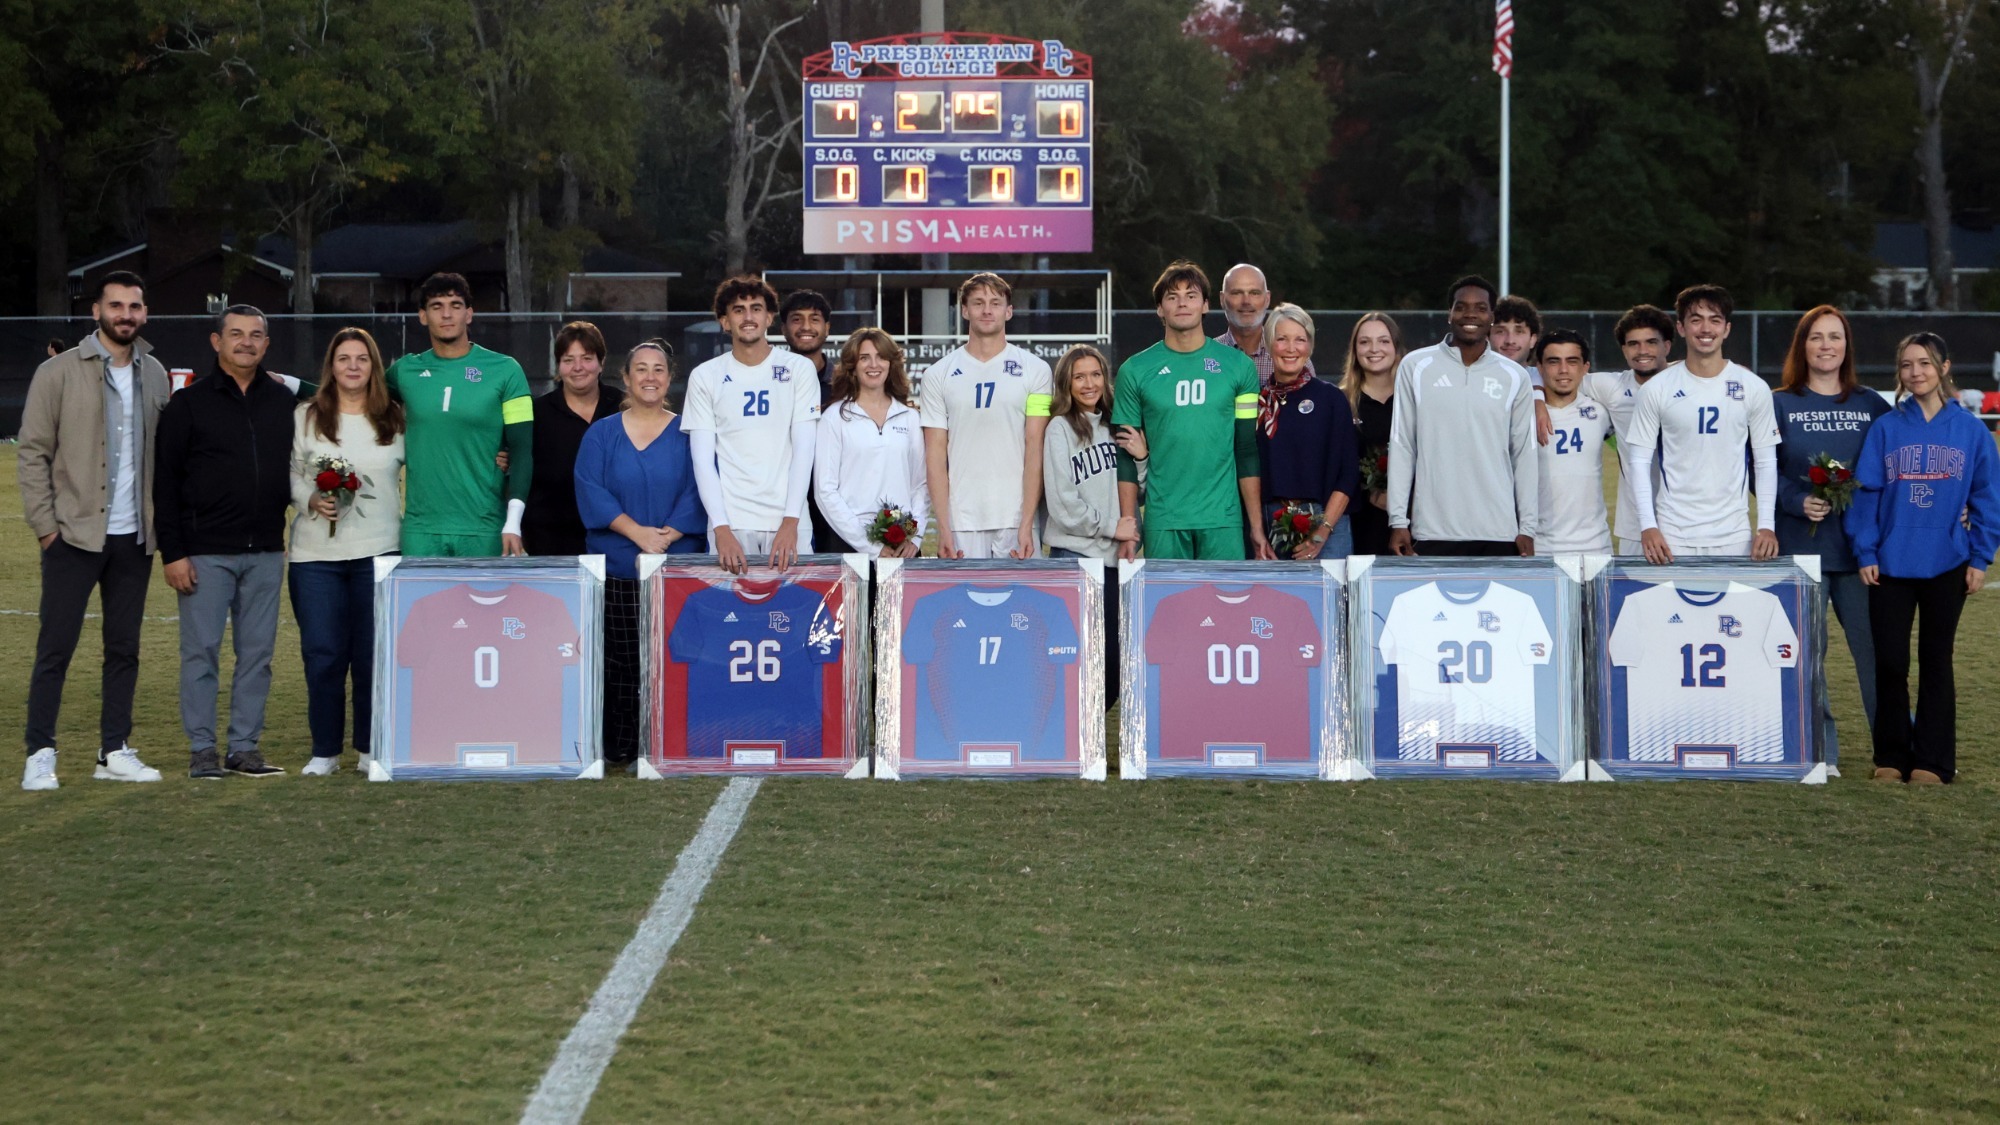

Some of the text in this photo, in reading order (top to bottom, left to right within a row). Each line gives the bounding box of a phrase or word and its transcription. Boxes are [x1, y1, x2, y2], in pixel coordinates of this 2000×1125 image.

[861, 44, 1034, 62] PRESBYTERIAN
[900, 60, 997, 77] COLLEGE
[810, 84, 865, 98] GUEST
[1034, 84, 1085, 98] HOME
[1060, 103, 1080, 135] 0
[815, 149, 857, 162] S.O.G.
[873, 149, 936, 162] C. KICKS
[960, 149, 1022, 162] C. KICKS
[1038, 149, 1080, 162] S.O.G.
[836, 167, 856, 200] 0
[905, 167, 925, 200] 0
[991, 167, 1011, 200] 0
[1060, 167, 1080, 200] 0
[837, 219, 962, 243] PRISMA
[1034, 344, 1072, 357] Stad
[442, 386, 452, 412] 1
[743, 390, 770, 416] 26
[975, 382, 995, 409] 17
[1175, 379, 1206, 406] 00
[1698, 406, 1720, 434] 12
[1788, 411, 1871, 423] PRESBYTERIAN
[1803, 421, 1861, 432] COLLEGE
[1554, 427, 1583, 454] 24
[1926, 444, 1965, 481] HOSE
[729, 640, 781, 682] 26
[979, 636, 1002, 665] 17
[1207, 643, 1260, 684] 00
[1437, 640, 1492, 683] 20
[474, 646, 499, 688] 0
[1680, 643, 1726, 687] 12
